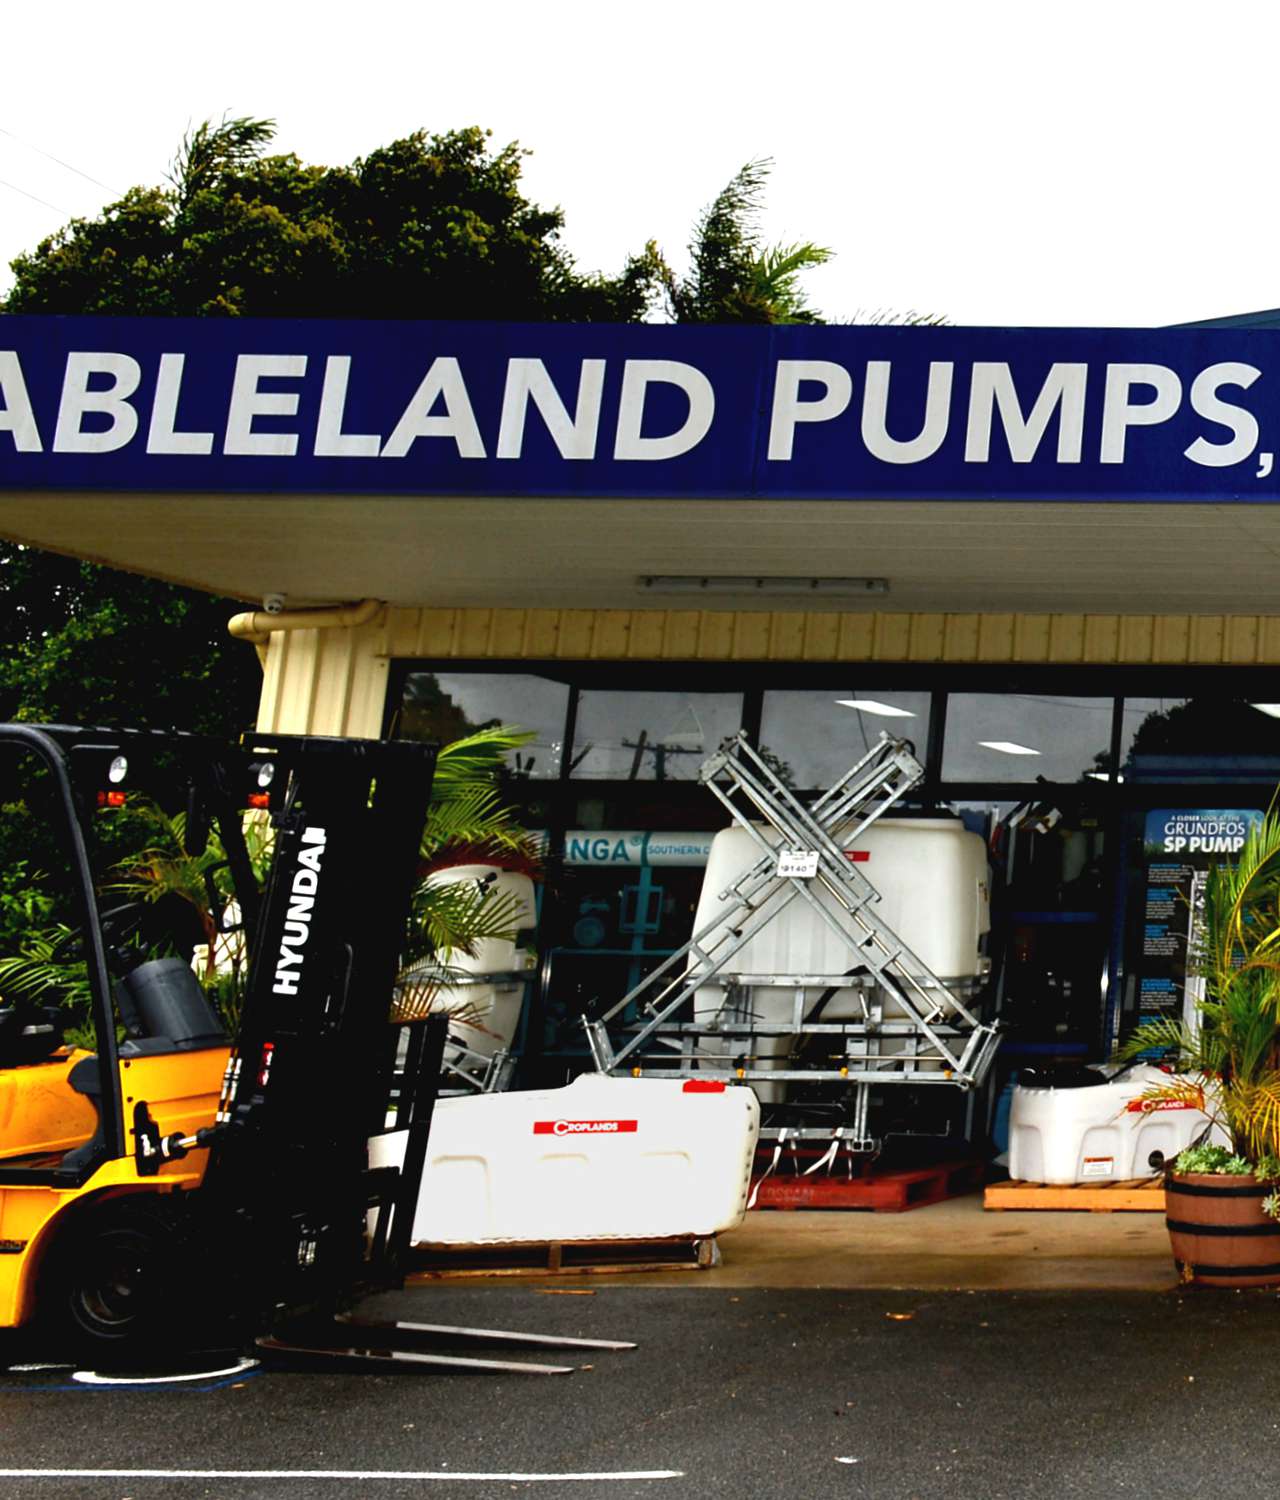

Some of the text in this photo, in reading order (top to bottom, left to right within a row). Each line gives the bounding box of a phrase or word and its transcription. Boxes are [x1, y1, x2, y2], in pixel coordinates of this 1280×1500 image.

[767, 360, 1273, 478] PUMPS,
[1164, 822, 1245, 835] GRUNDFOS
[1164, 836, 1245, 853] SP PUMP
[272, 827, 327, 995] HYUNDAI
[553, 1120, 618, 1136] CROPLANDS
